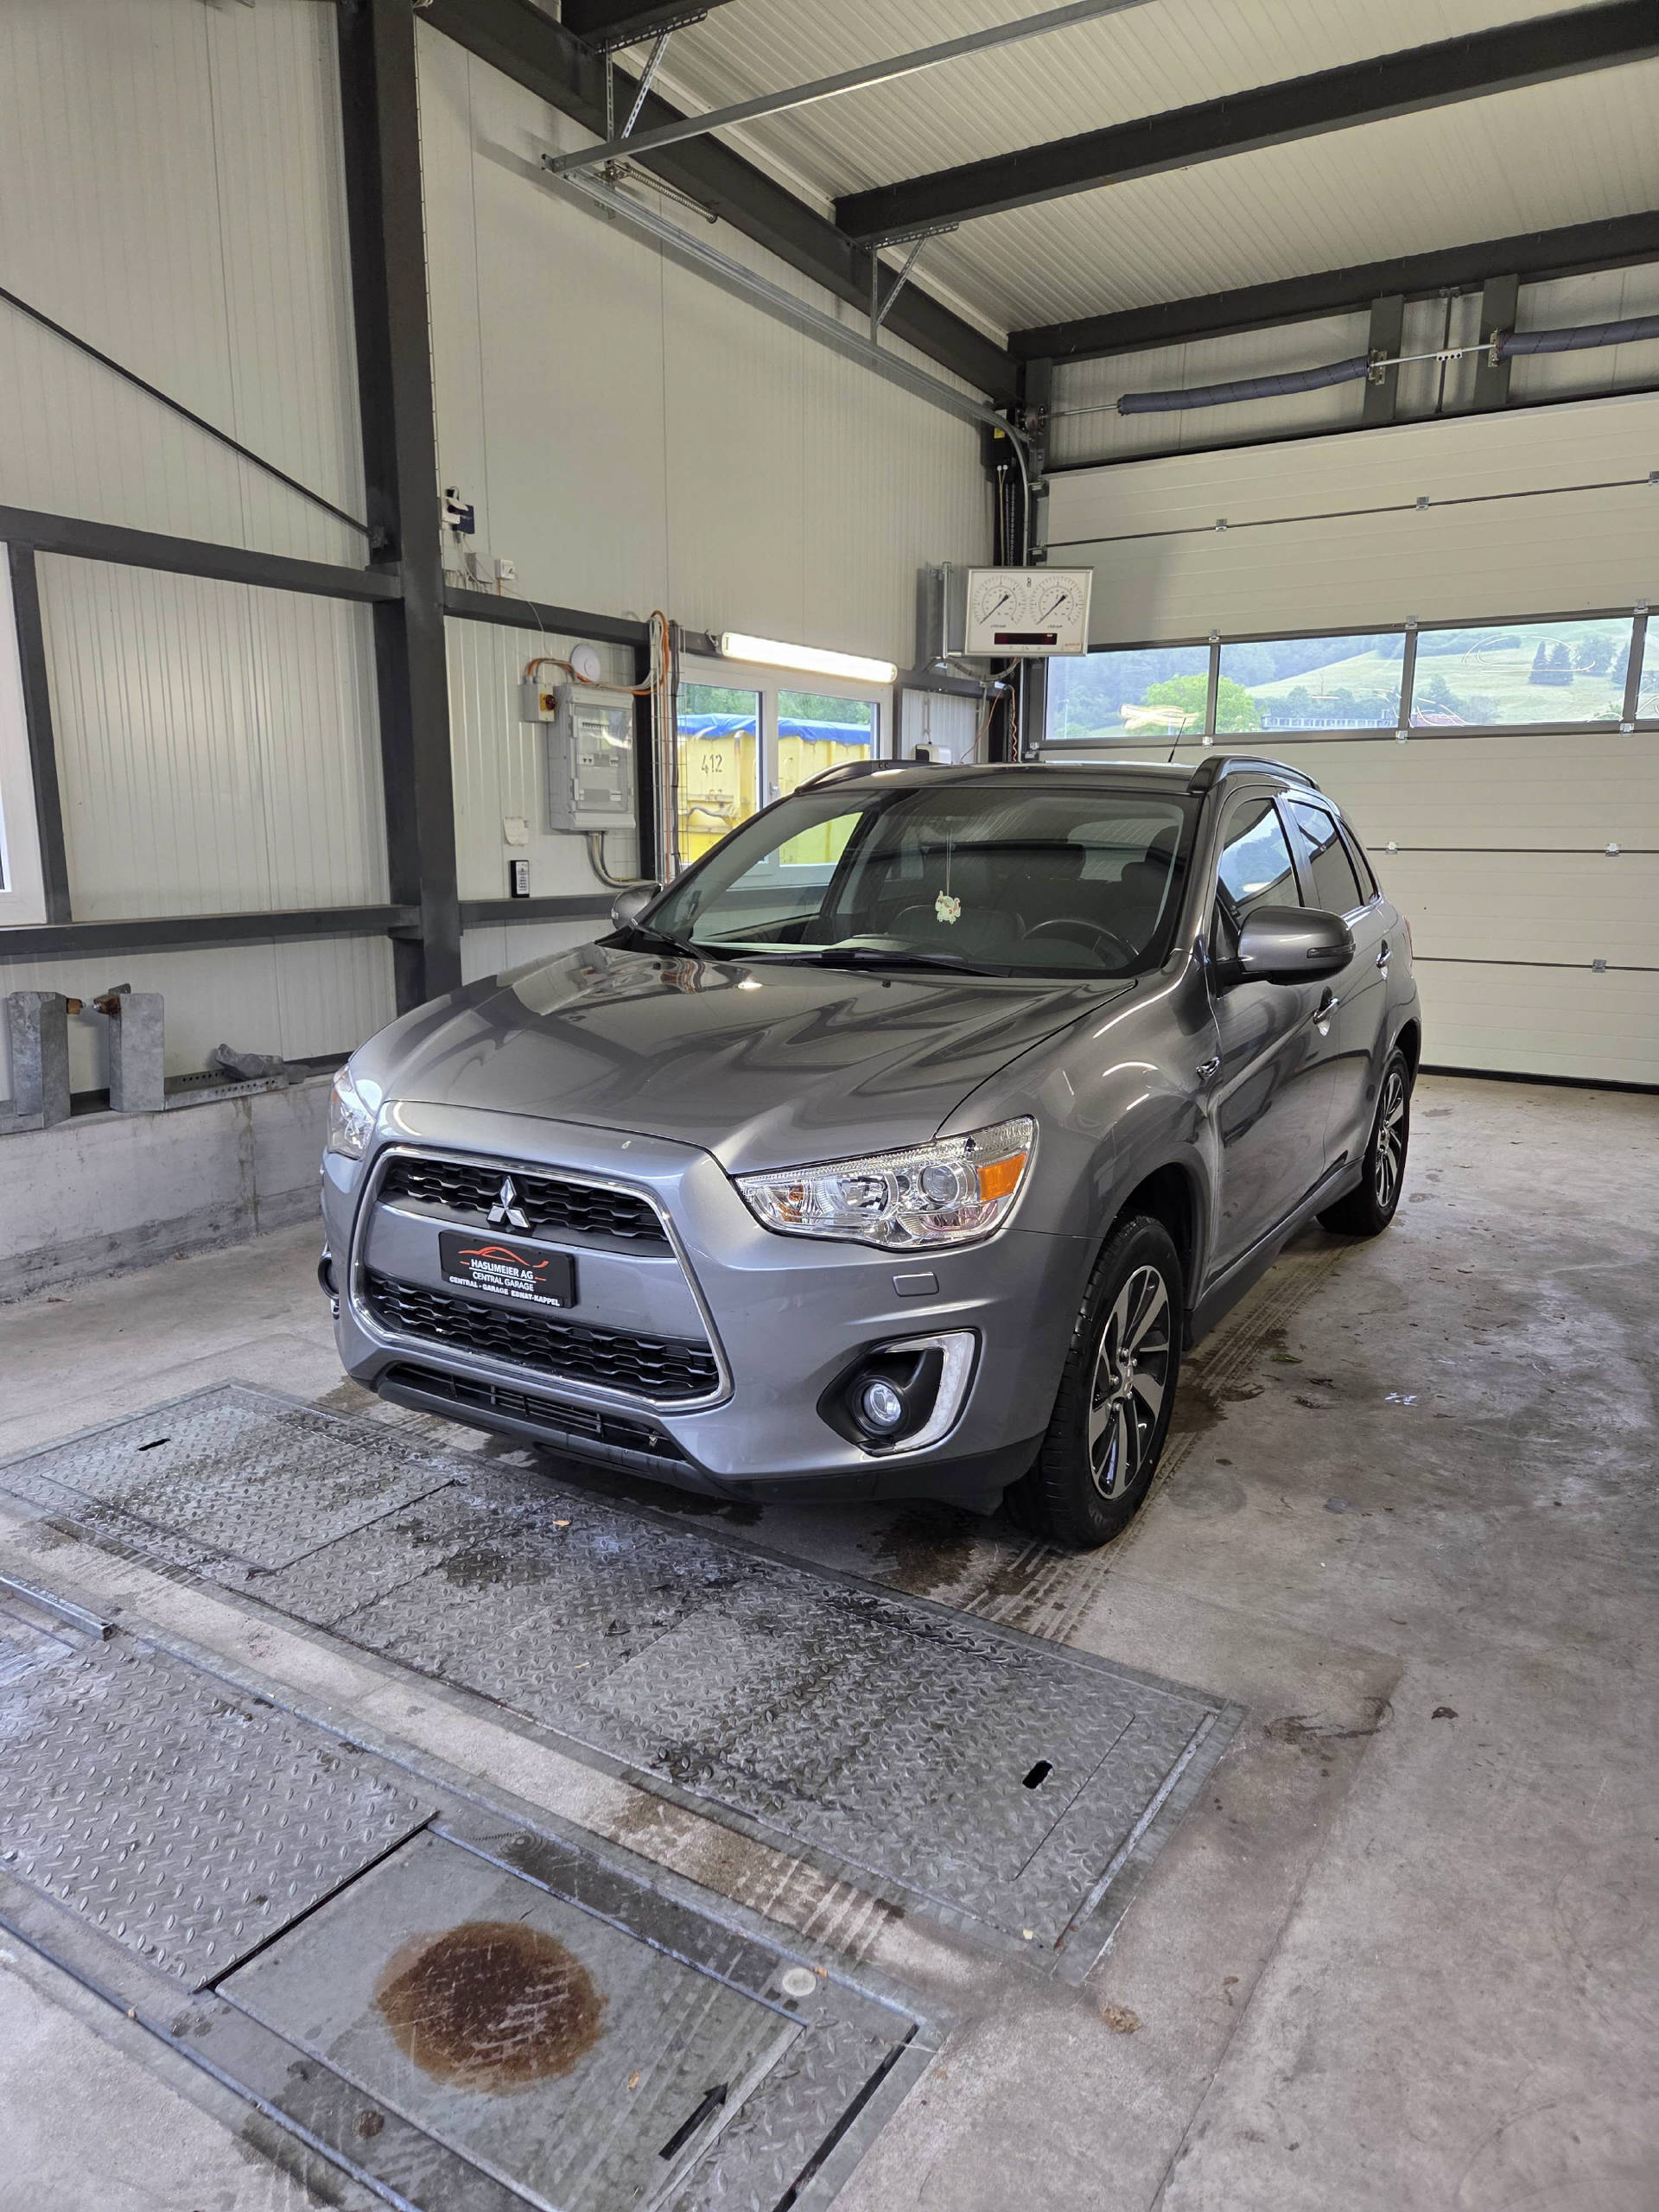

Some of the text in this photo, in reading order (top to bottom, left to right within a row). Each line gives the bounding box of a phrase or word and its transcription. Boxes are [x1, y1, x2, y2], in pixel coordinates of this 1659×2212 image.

[701, 754, 722, 774] 412
[471, 1258, 534, 1280] HASLIMEIER AG
[449, 1275, 479, 1288] CENTRAL
[482, 1283, 509, 1295] GARAGE
[472, 1271, 534, 1292] CENTRAL GARAGE
